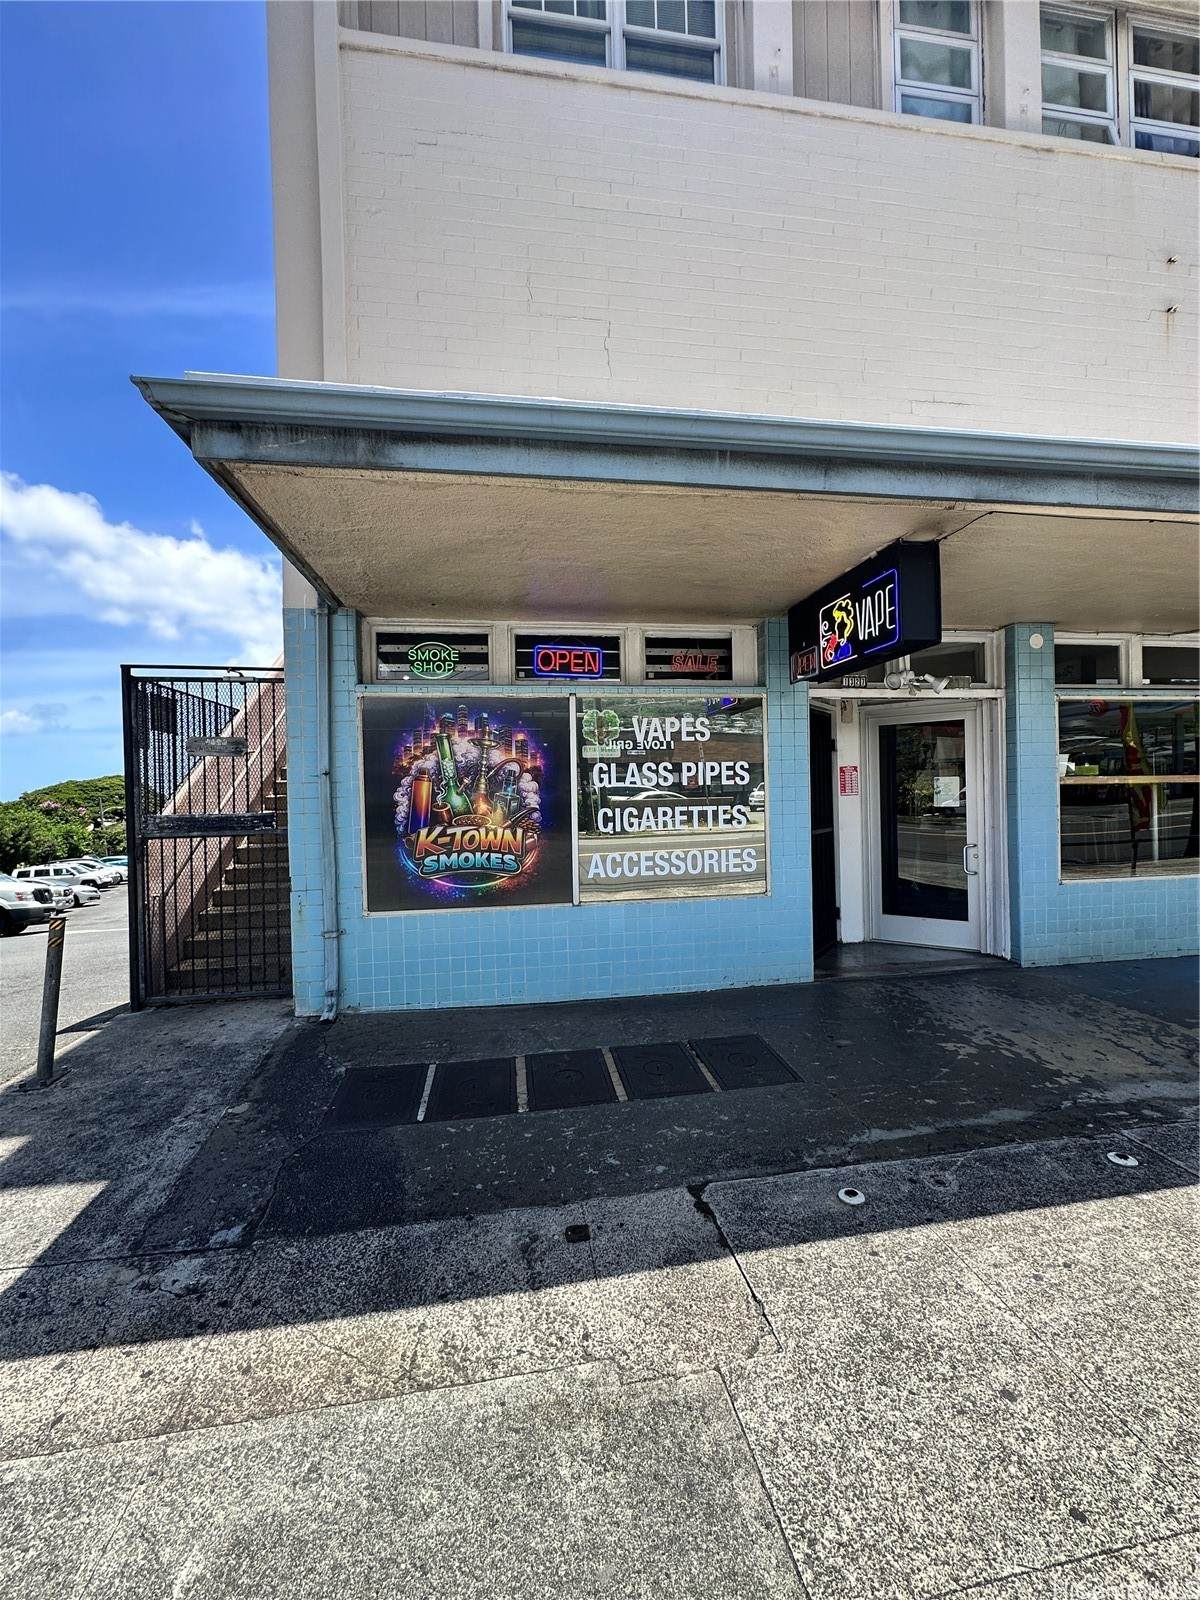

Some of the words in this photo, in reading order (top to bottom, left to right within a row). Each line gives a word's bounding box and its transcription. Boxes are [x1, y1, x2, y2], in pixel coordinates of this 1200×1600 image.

[855, 584, 896, 641] VAPE
[408, 649, 460, 662] SMOKE
[413, 661, 455, 673] SHOP
[537, 649, 599, 673] OPEN
[671, 653, 719, 673] SALE
[791, 651, 817, 679] OPEN
[631, 716, 711, 742] VAPES
[592, 762, 674, 787] GLASS
[682, 761, 750, 786] PIPES
[597, 804, 748, 834] CIGARETTES
[415, 826, 524, 858] K-TOWN
[422, 852, 518, 873] SMOKES
[587, 848, 758, 879] ACCESSORIES
